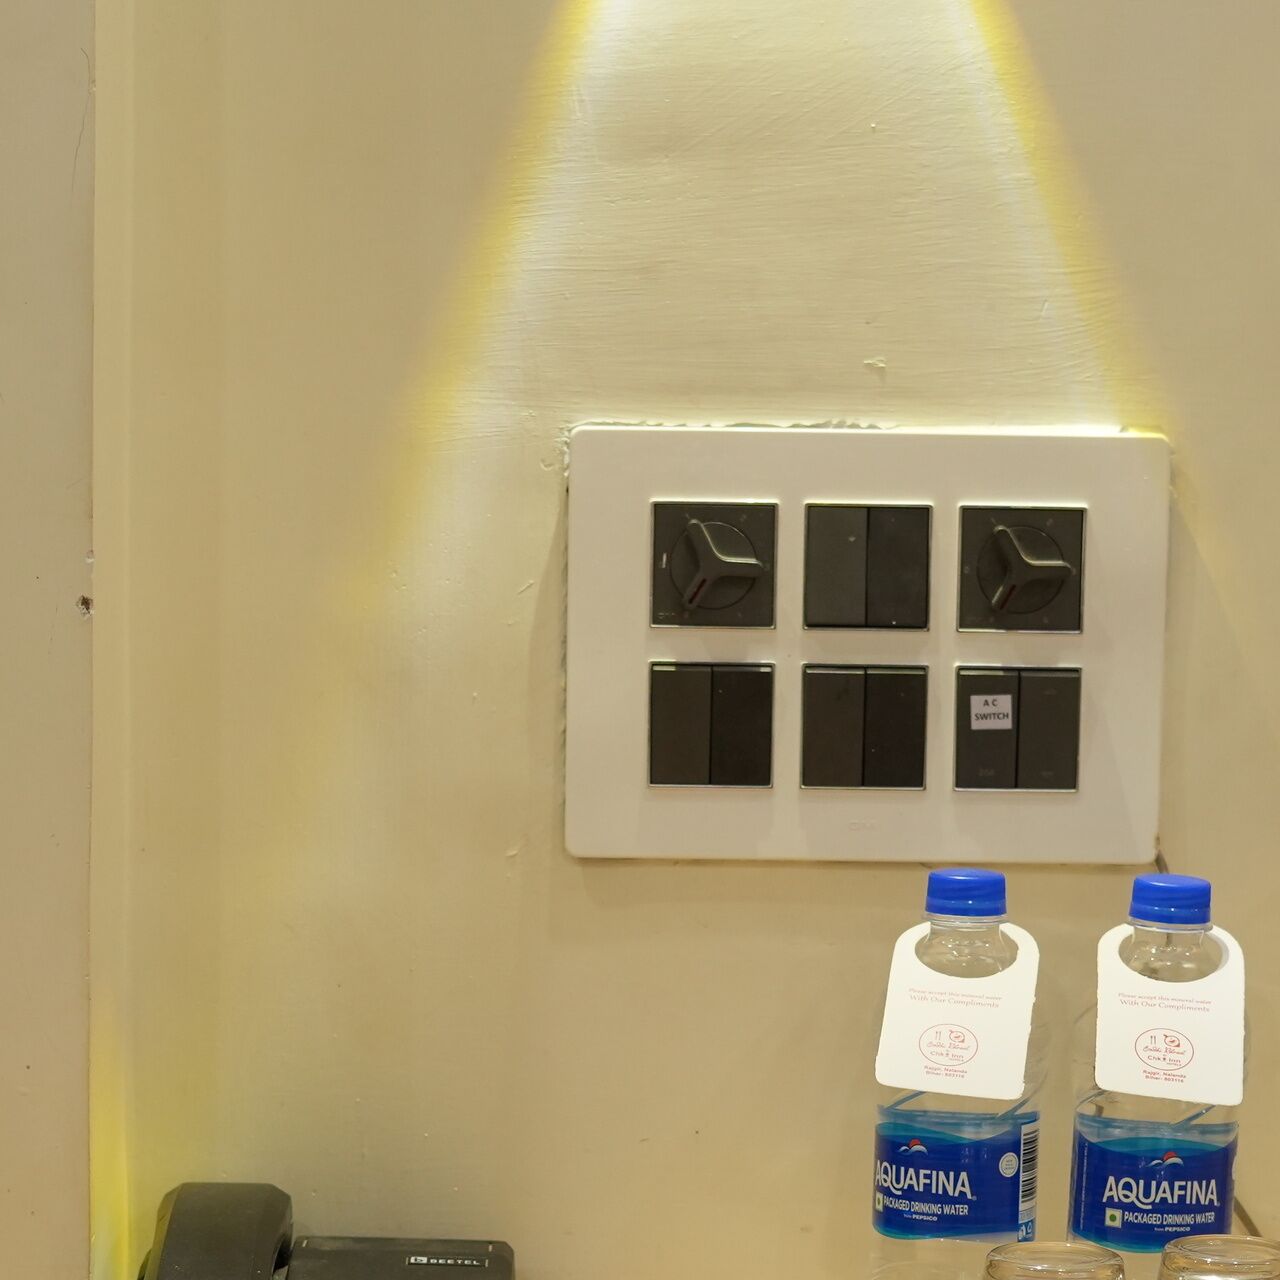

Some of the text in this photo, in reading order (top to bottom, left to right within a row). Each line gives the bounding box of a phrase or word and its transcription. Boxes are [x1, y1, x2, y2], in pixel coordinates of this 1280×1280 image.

[991, 699, 998, 707] C
[974, 712, 1009, 720] SWITCH
[948, 997, 1000, 1008] Compliments
[1158, 1002, 1210, 1012] Compliments
[875, 1160, 972, 1200] AQUAFINA
[1102, 1176, 1218, 1209] AQUAFINA
[884, 1196, 969, 1215] PACKAGED DRINKING WATER
[1124, 1211, 1215, 1225] PACKAGED DRINKING WATER
